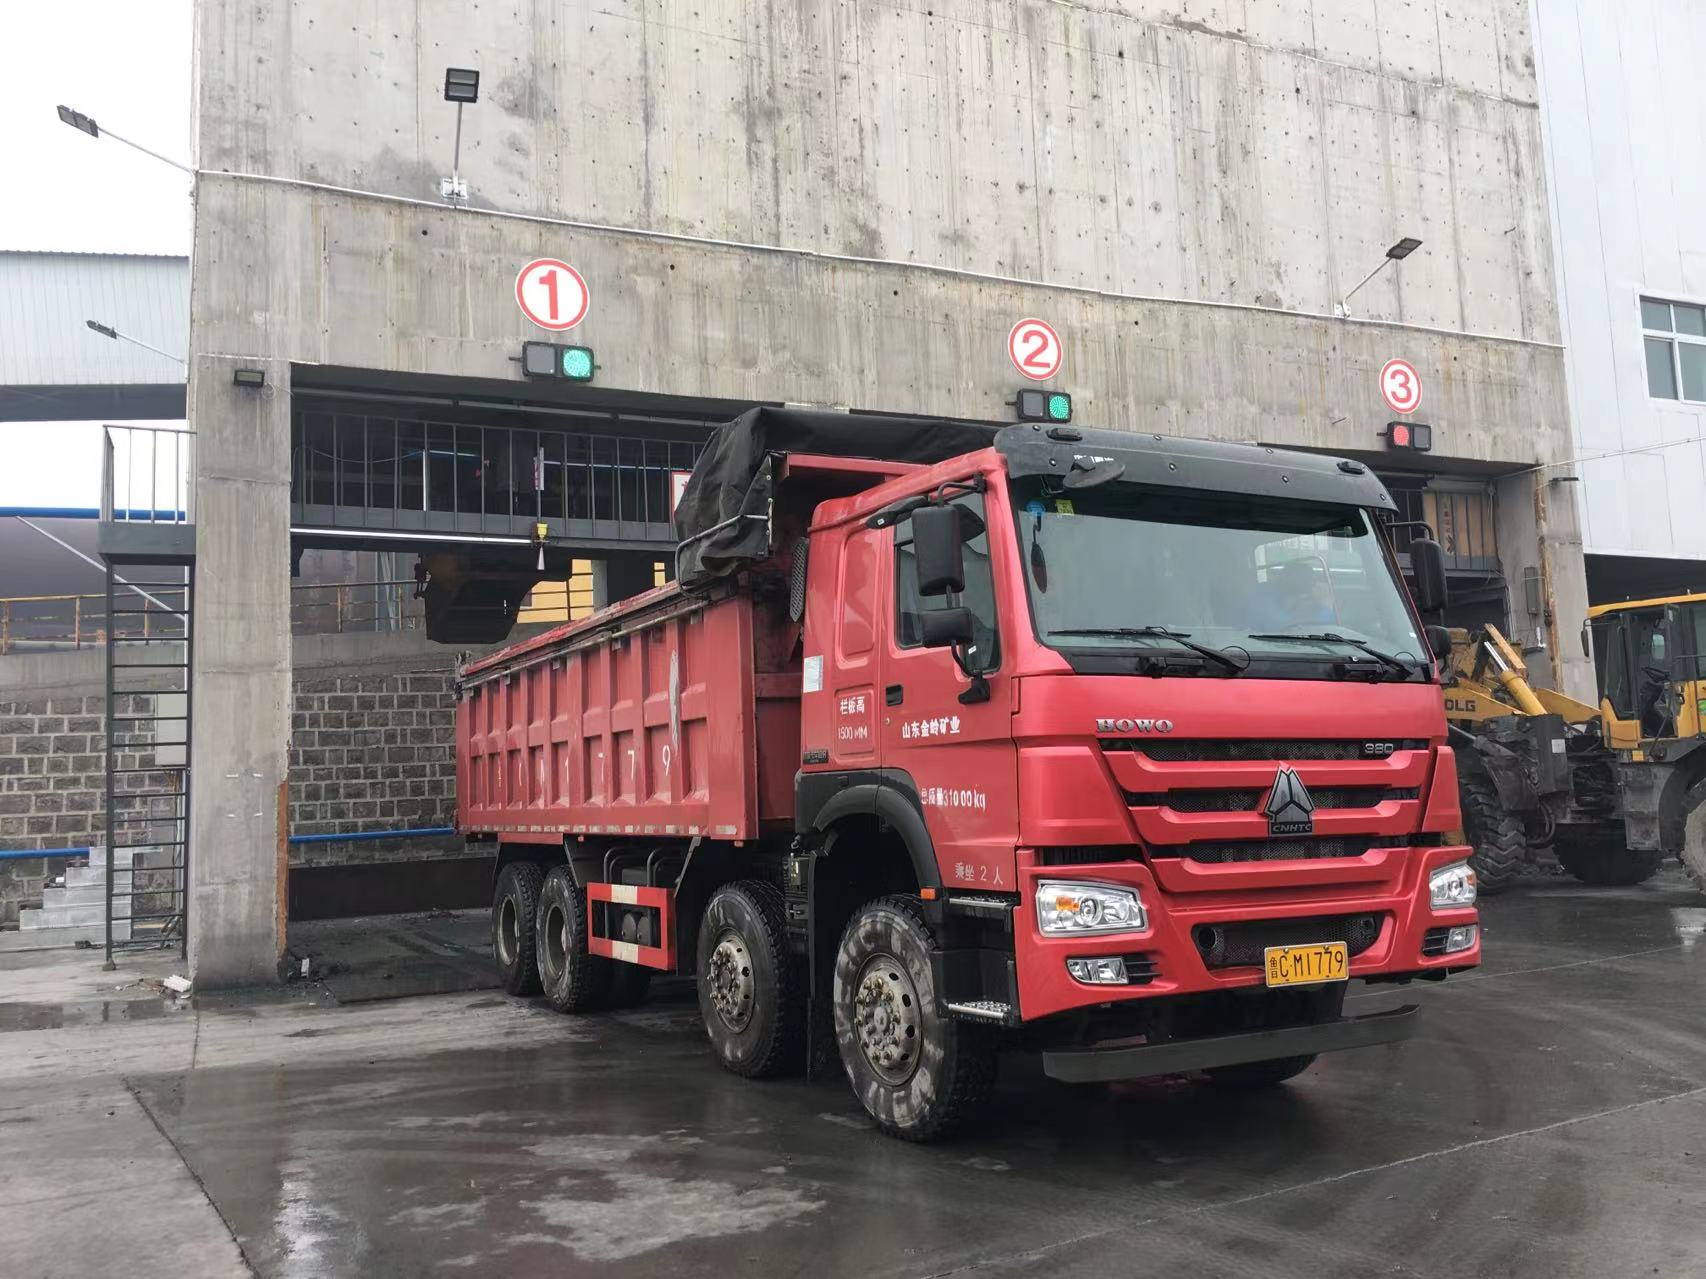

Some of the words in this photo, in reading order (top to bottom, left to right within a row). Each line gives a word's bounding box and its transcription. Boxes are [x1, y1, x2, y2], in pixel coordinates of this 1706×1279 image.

[538, 269, 559, 321] 1
[1022, 329, 1051, 369] 2
[1390, 369, 1412, 404] 3
[1096, 718, 1174, 733] HOWO
[1364, 743, 1394, 754] 380
[1272, 823, 1312, 832] CNHTC
